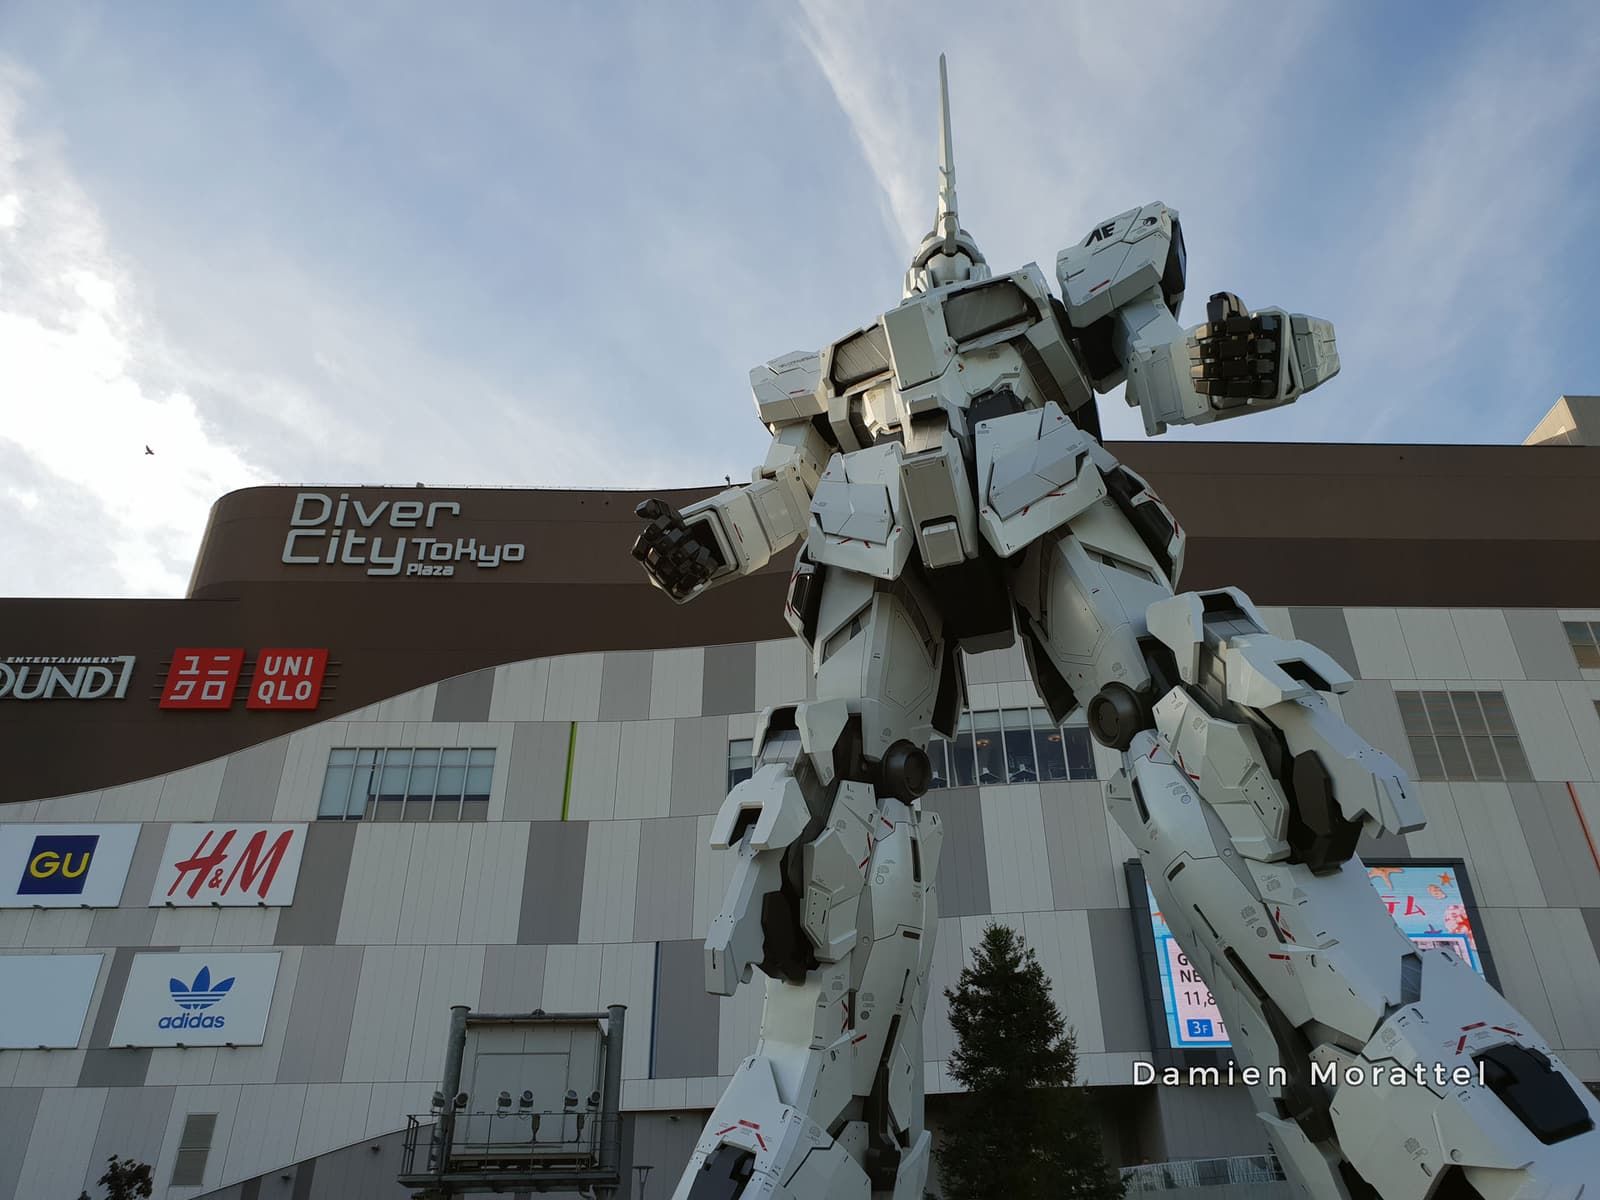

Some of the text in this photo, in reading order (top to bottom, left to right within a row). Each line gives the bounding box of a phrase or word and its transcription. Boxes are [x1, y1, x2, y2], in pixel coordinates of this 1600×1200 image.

[290, 493, 460, 528] Diver
[281, 529, 406, 576] City
[406, 563, 455, 576] Plaza
[6, 656, 119, 664] ENTERTAINMENT
[263, 656, 314, 676] UNI
[257, 680, 312, 705] QLO
[29, 851, 90, 879] GU
[167, 829, 294, 899] H&M
[158, 1012, 225, 1029] adidas
[1191, 1021, 1209, 1034] 3F
